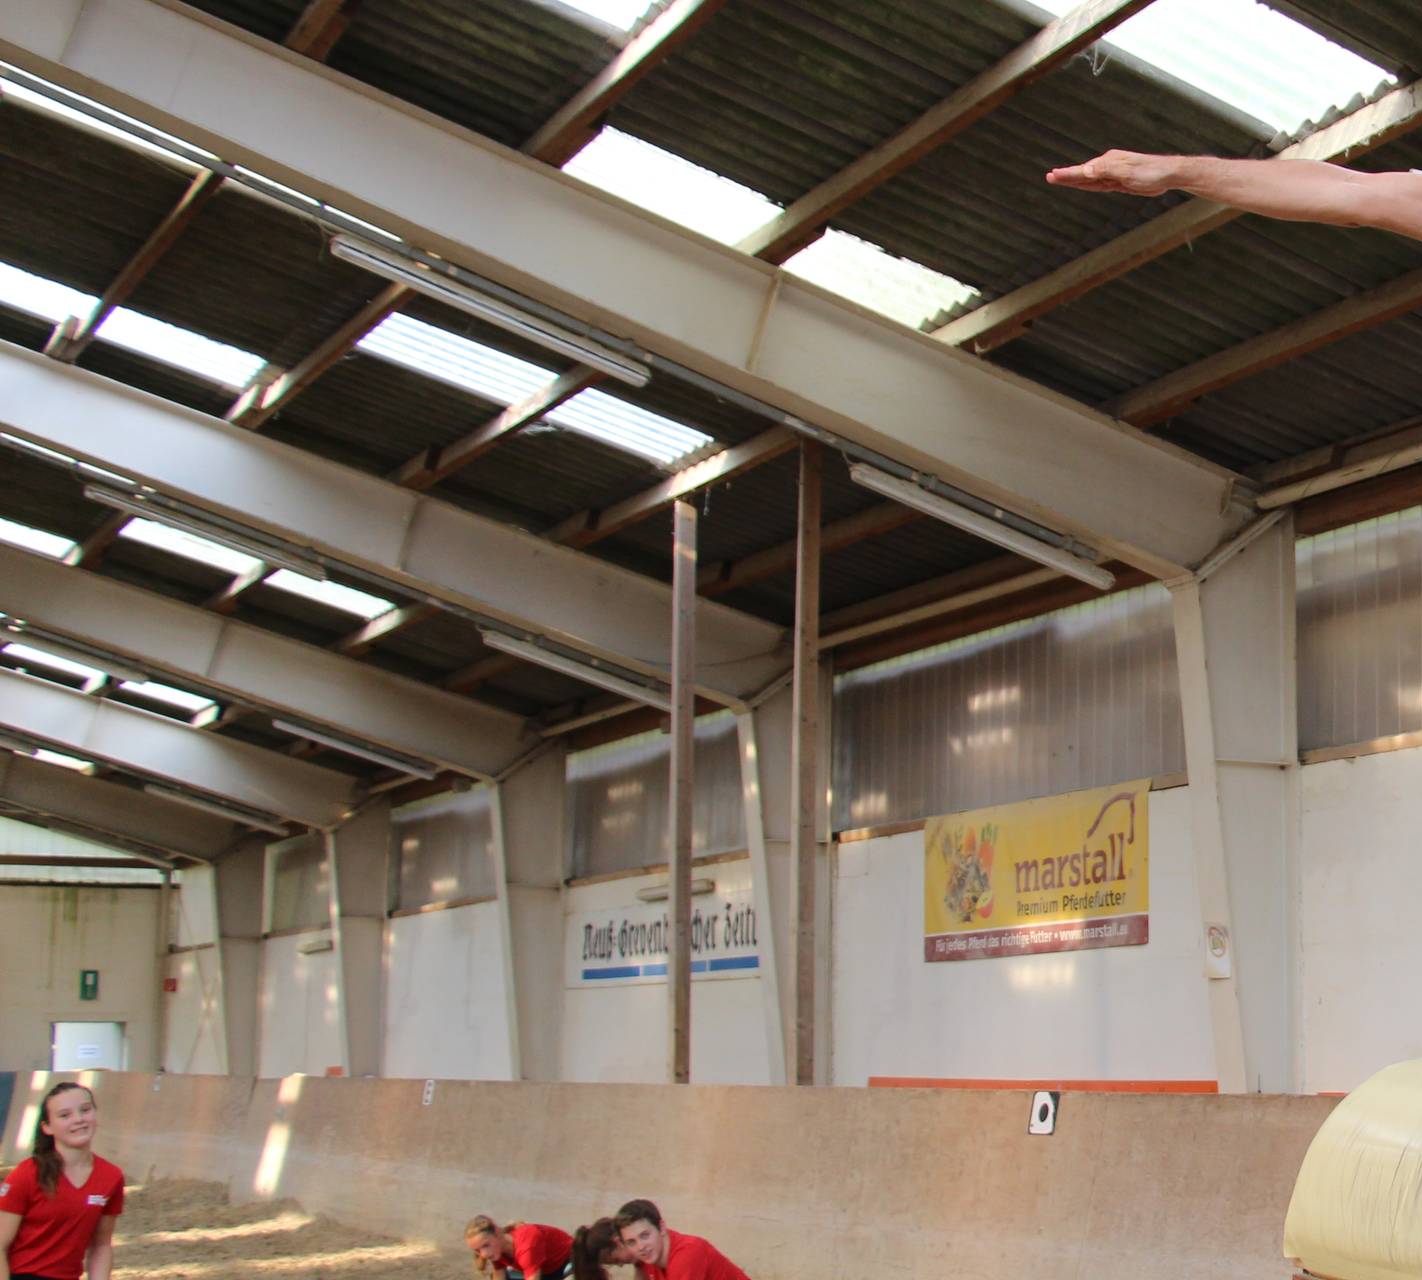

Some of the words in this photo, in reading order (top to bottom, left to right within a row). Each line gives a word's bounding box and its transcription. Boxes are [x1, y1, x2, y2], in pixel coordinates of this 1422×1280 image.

[1014, 832, 1126, 893] marstall
[1016, 897, 1059, 917] Premium
[1062, 891, 1127, 912] Pferdefutter
[967, 935, 987, 950] Pferd
[988, 934, 1000, 948] das
[1001, 931, 1030, 949] richtige
[1030, 930, 1053, 944] Futter
